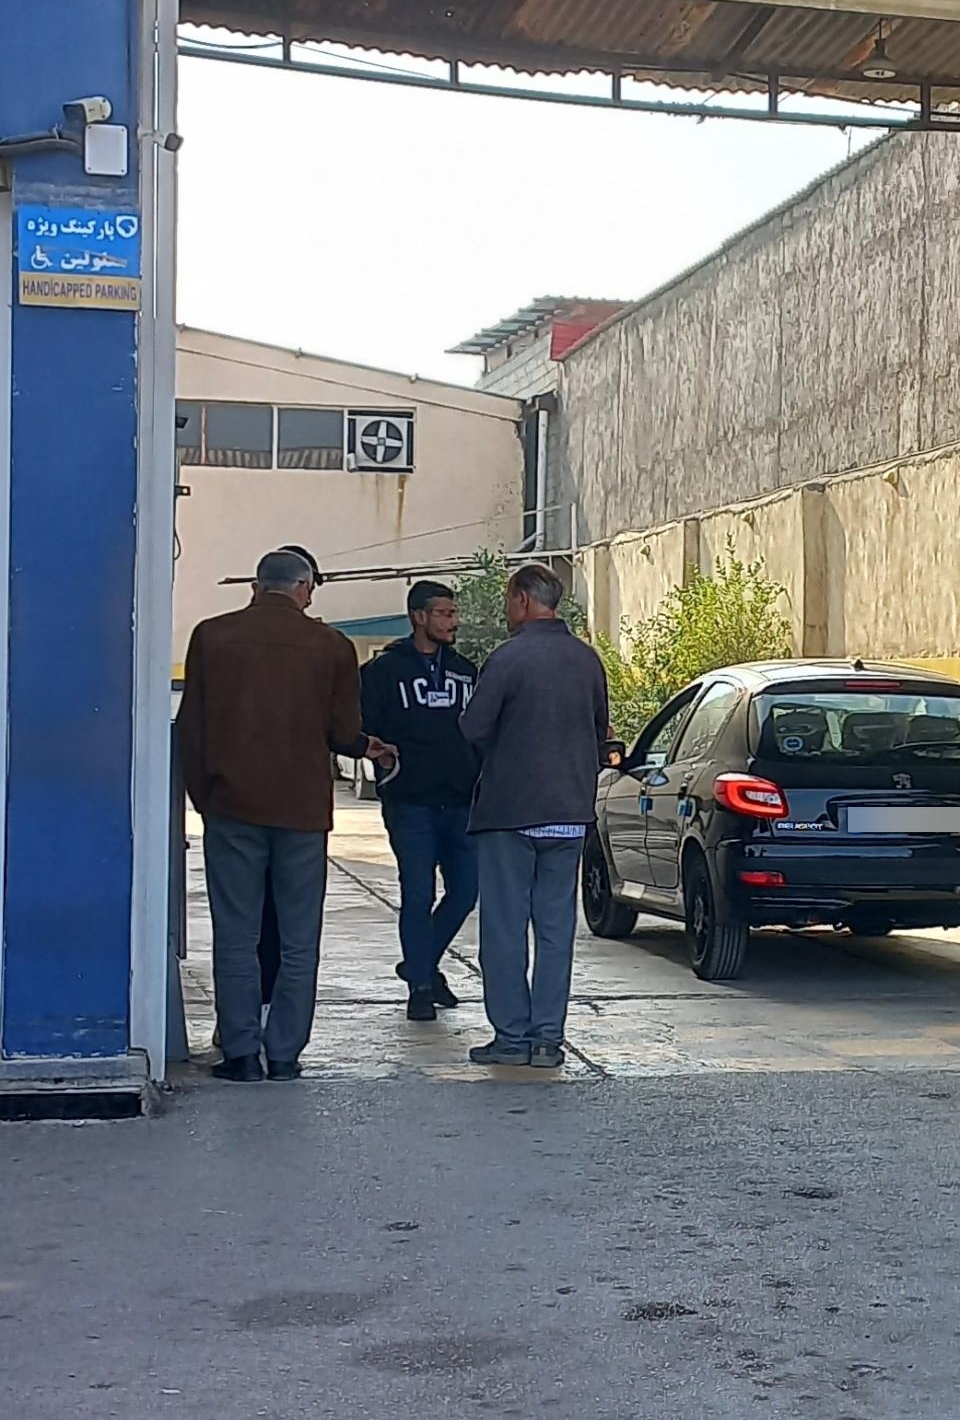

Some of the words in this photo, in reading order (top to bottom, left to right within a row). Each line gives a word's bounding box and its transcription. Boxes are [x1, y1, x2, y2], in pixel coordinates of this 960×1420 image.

[27, 217, 58, 236] ویژه
[22, 279, 93, 299] HANDICAPPED
[95, 284, 137, 301] PARKING
